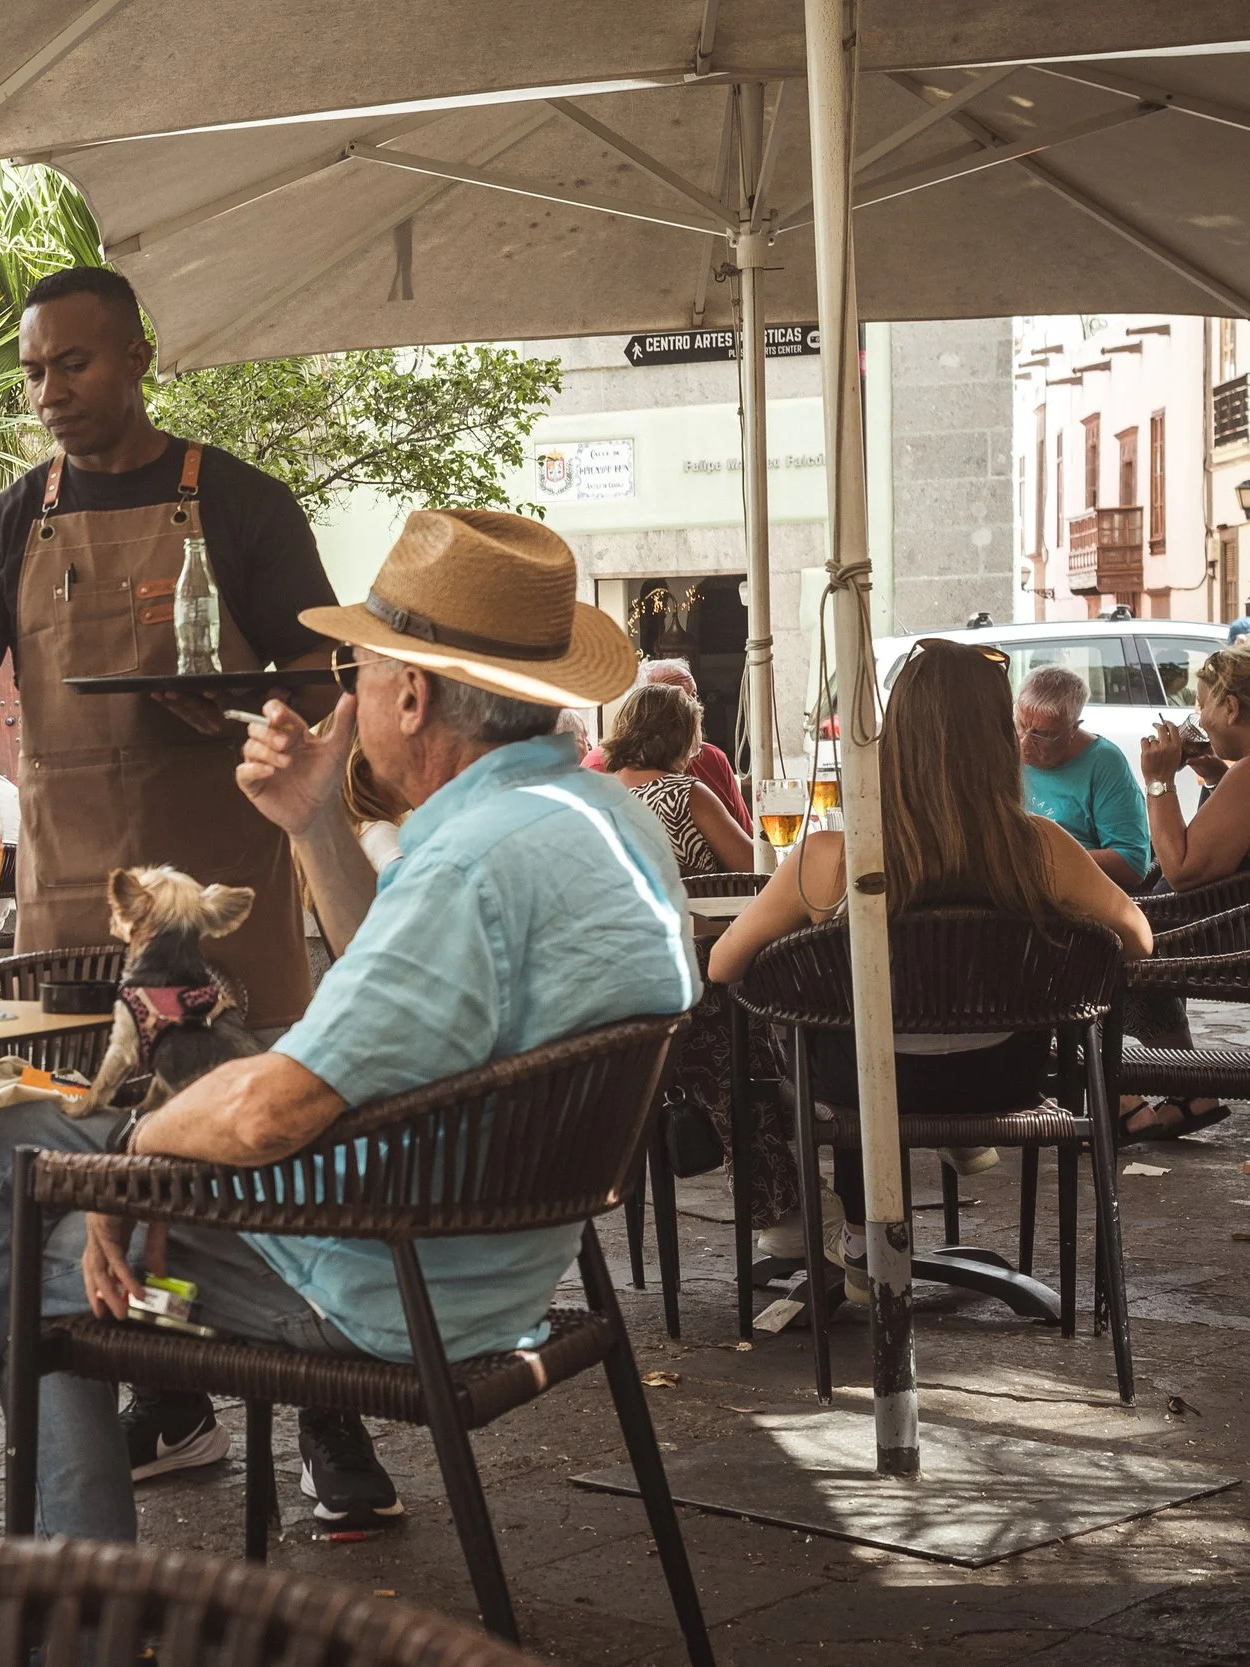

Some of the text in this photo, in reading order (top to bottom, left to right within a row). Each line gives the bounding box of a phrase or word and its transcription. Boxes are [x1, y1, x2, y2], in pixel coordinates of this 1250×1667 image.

[646, 335, 690, 352] CENTRO
[694, 332, 733, 349] ARTES
[778, 345, 802, 355] CENTER
